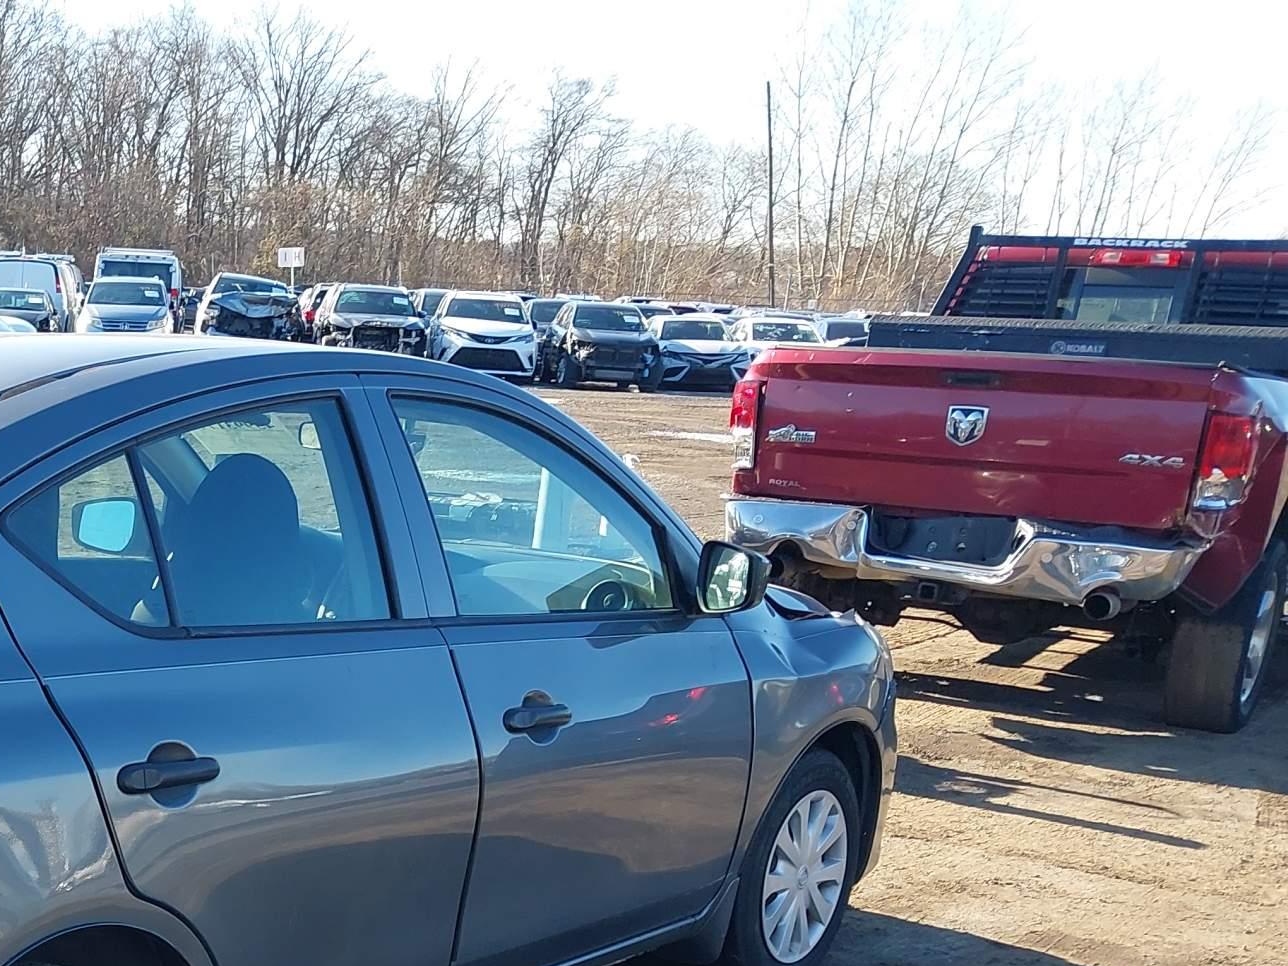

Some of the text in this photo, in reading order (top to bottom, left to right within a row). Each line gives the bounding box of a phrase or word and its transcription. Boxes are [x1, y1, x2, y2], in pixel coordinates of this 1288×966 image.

[1073, 238, 1189, 249] BACKRACK
[1066, 343, 1105, 353] KOBALT
[1118, 453, 1185, 467] 4X4
[768, 478, 801, 488] ROYAL
